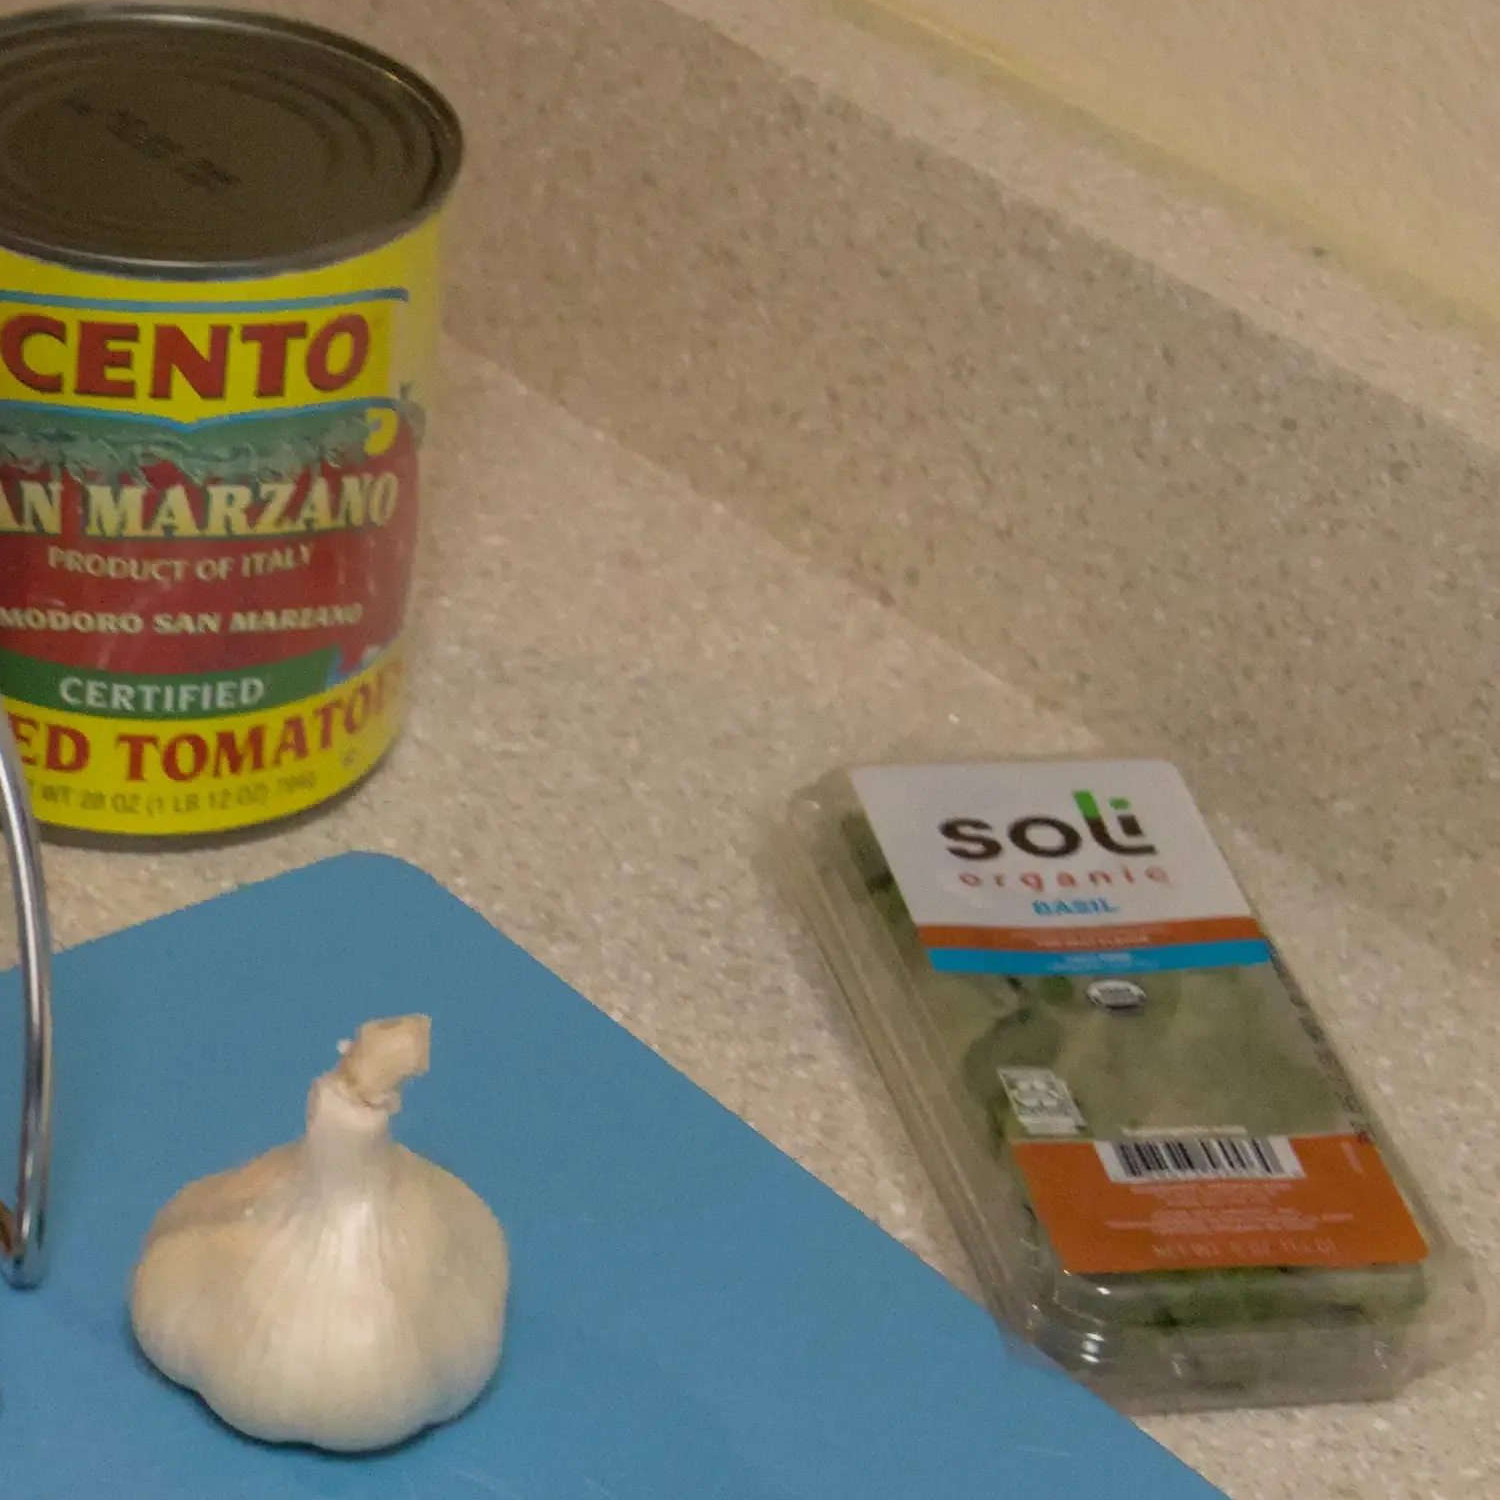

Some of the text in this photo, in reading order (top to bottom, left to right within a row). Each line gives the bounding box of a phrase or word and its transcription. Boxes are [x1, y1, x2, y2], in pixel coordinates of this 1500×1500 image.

[85, 472, 398, 538] MARZANO
[47, 542, 315, 582] PRODUCT OF ITALY
[151, 605, 222, 634] SAN
[228, 602, 364, 634] MARZANO
[59, 676, 265, 713] CERTIFIED
[957, 864, 1173, 893] organic
[1031, 896, 1121, 917] BASIL
